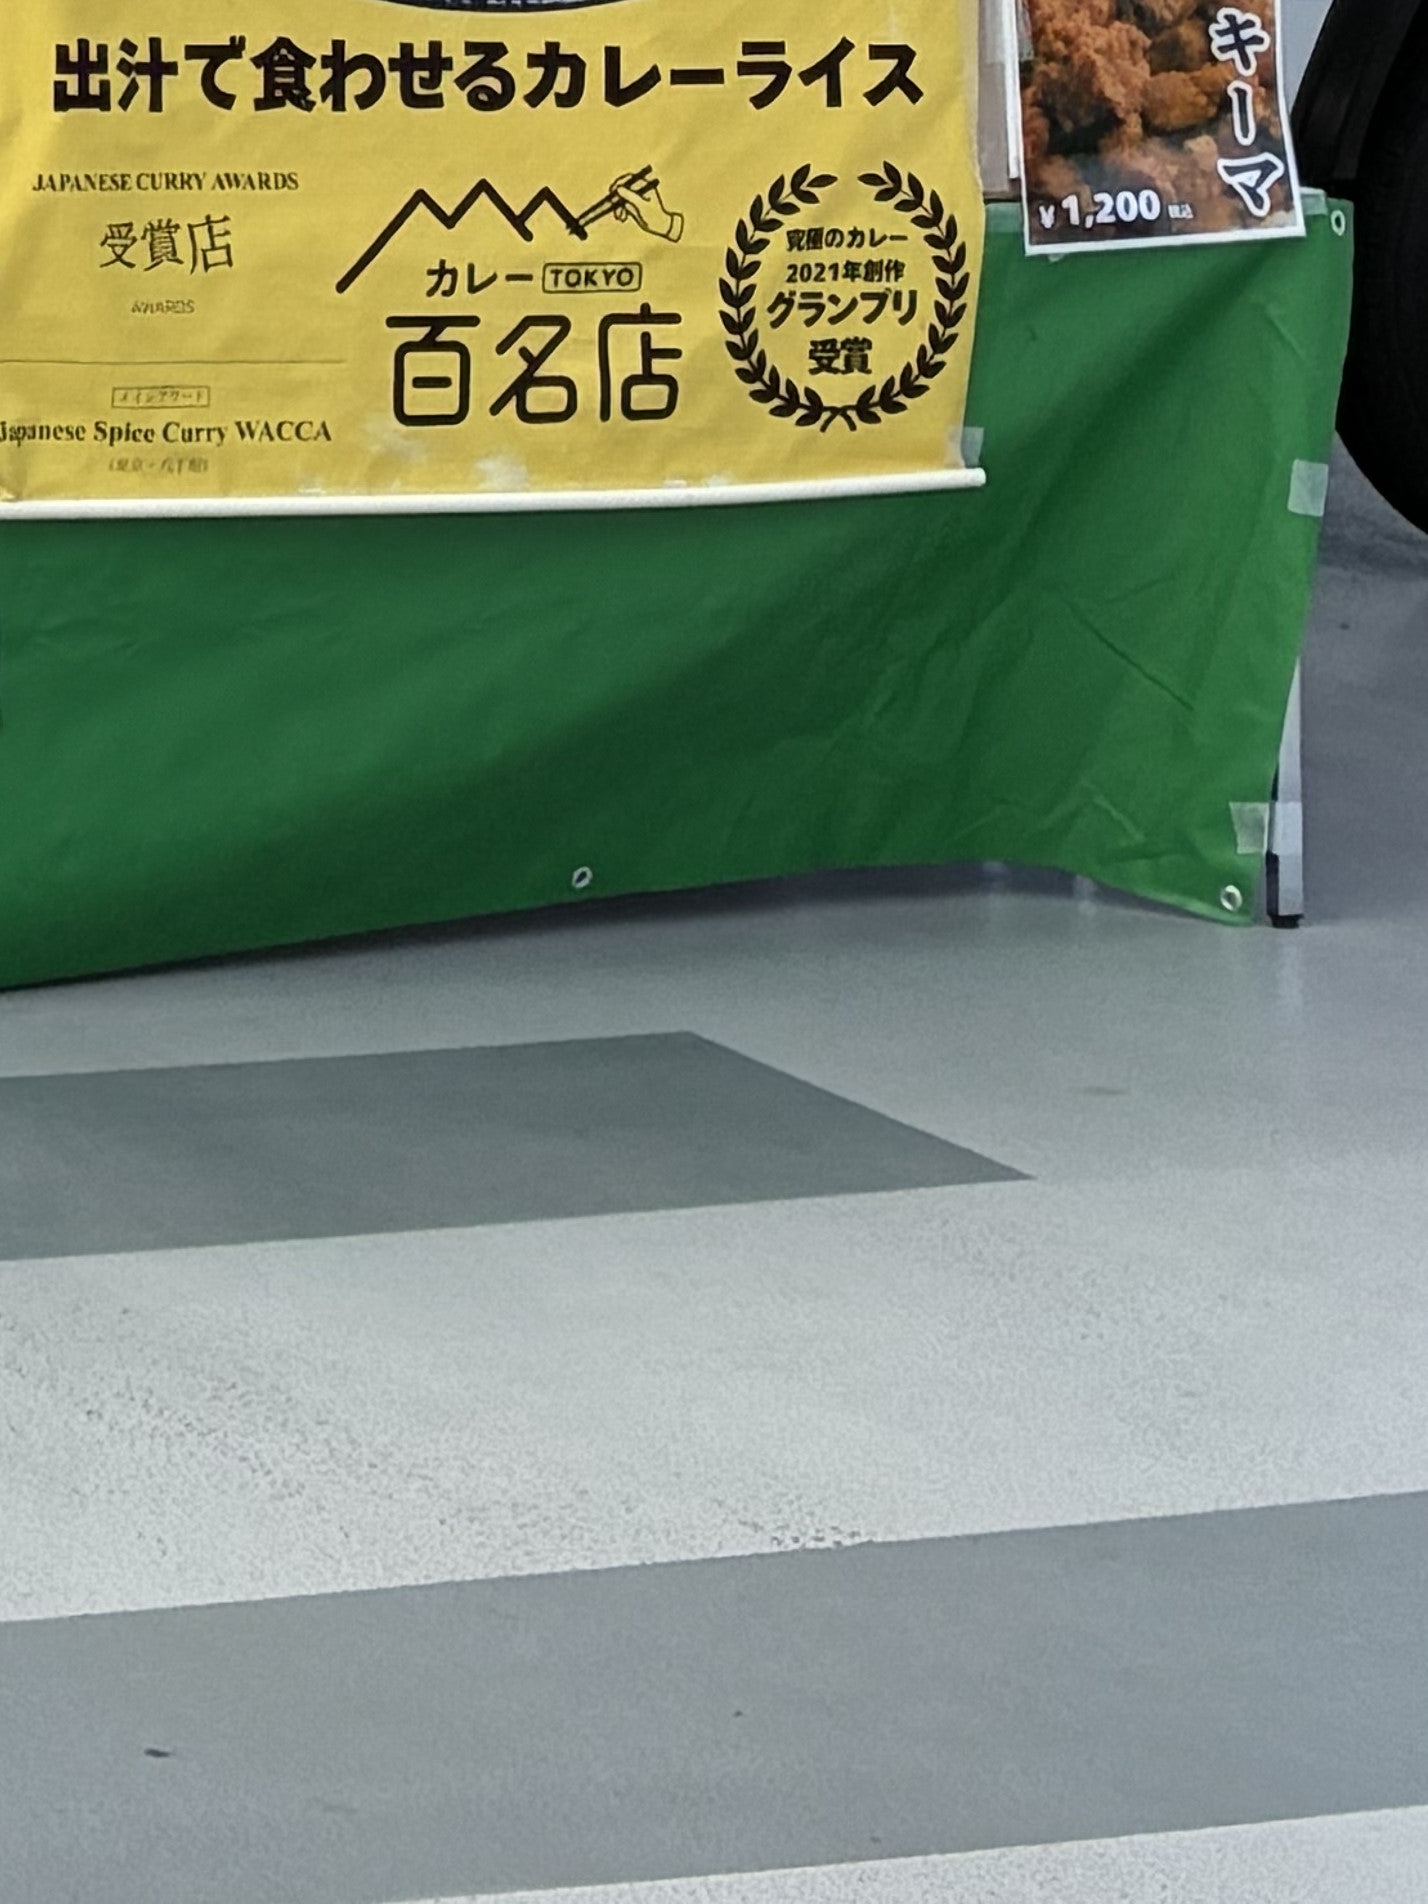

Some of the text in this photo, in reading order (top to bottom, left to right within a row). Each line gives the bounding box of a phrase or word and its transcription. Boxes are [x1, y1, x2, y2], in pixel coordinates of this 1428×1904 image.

[50, 34, 927, 116] 出汁で食わせるカレーライス
[33, 170, 300, 193] JAPANESE CURRY AWARDS
[98, 212, 235, 276] 受賞店
[425, 258, 635, 298] カレー TOKYO
[785, 258, 906, 284] 2021年創作
[385, 301, 683, 428] 百名店
[808, 336, 873, 376] 受賞
[93, 420, 156, 448] Spice
[162, 421, 229, 448] Curry
[234, 419, 334, 443] WACCA
